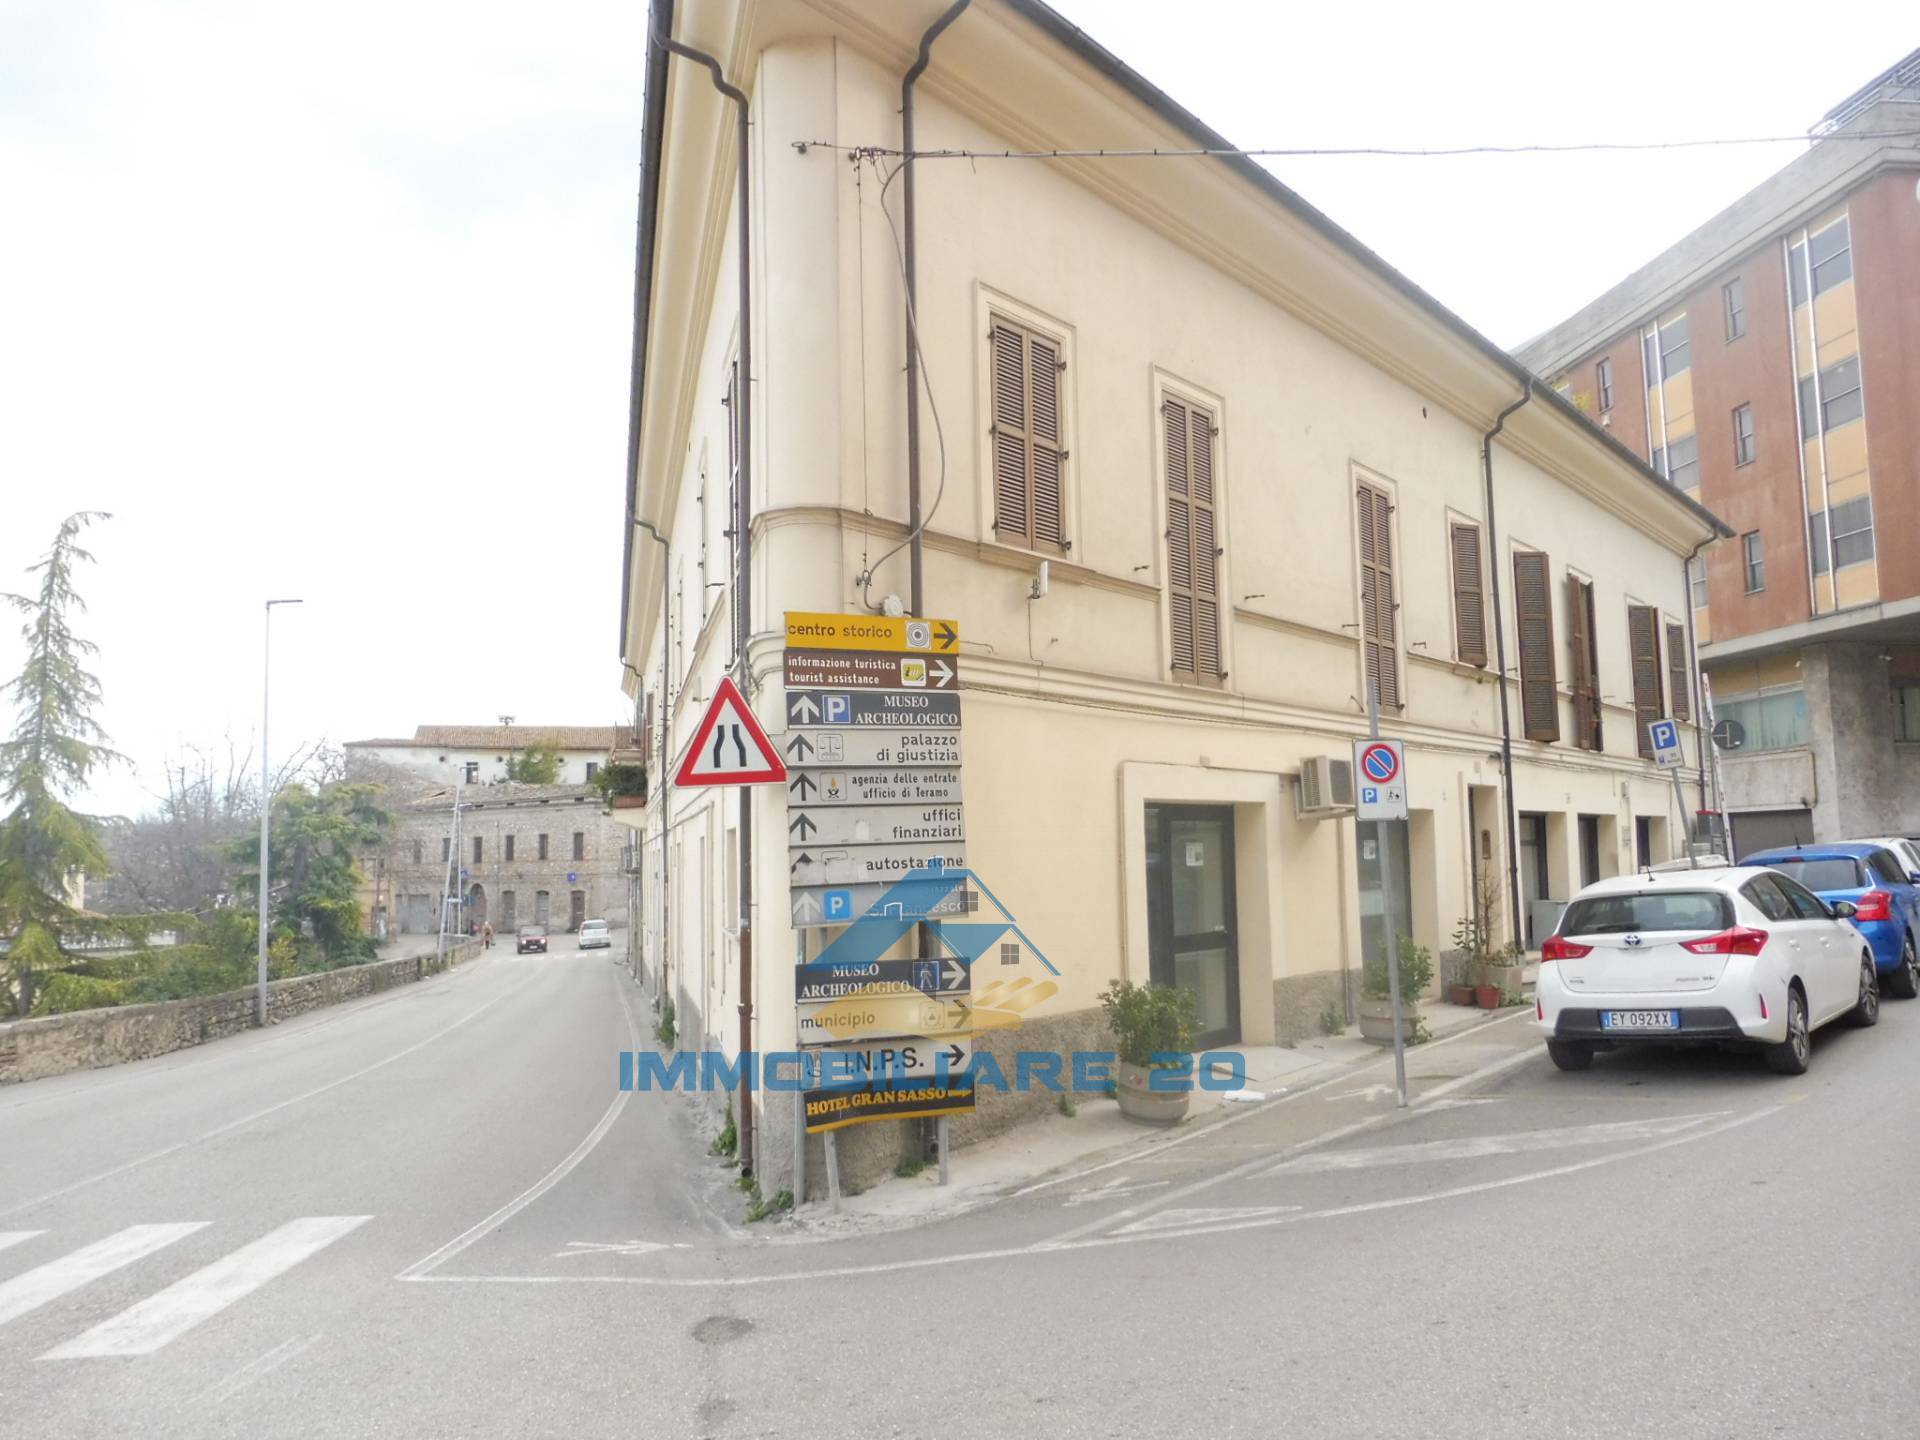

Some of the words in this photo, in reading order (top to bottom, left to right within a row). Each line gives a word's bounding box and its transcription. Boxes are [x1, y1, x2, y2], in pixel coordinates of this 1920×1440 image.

[788, 624, 836, 636] centro
[843, 625, 893, 639] storico
[788, 656, 851, 669] informazione
[855, 658, 896, 670] turistica
[790, 672, 824, 683] tourist
[828, 673, 880, 684] assistance
[884, 695, 929, 708] MUSEO
[827, 697, 845, 722] P
[855, 712, 958, 725] ARCHEOLOGICO
[901, 734, 957, 748] palazzo
[1656, 726, 1671, 747] P
[876, 749, 889, 761] di
[897, 749, 959, 763] giustizia
[852, 773, 888, 787] agenzia
[893, 773, 918, 784] delle
[923, 773, 957, 783] entrate
[863, 788, 896, 799] ufficio
[902, 787, 911, 798] di
[916, 786, 949, 798] Teramo
[1364, 789, 1375, 802] P
[922, 809, 961, 822] uffici
[893, 825, 962, 839] finanziari
[866, 855, 964, 871] autostazione
[831, 896, 844, 914] P
[832, 963, 880, 977] MUSEO
[801, 980, 910, 998] ARCHEOLOGICO
[801, 1012, 876, 1029] municipio
[1610, 1010, 1626, 1026] EY
[1630, 1010, 1669, 1026] 092XX
[807, 1097, 850, 1116] HOTEL
[852, 1090, 896, 1106] GRAN
[897, 1087, 946, 1100] SASSO
